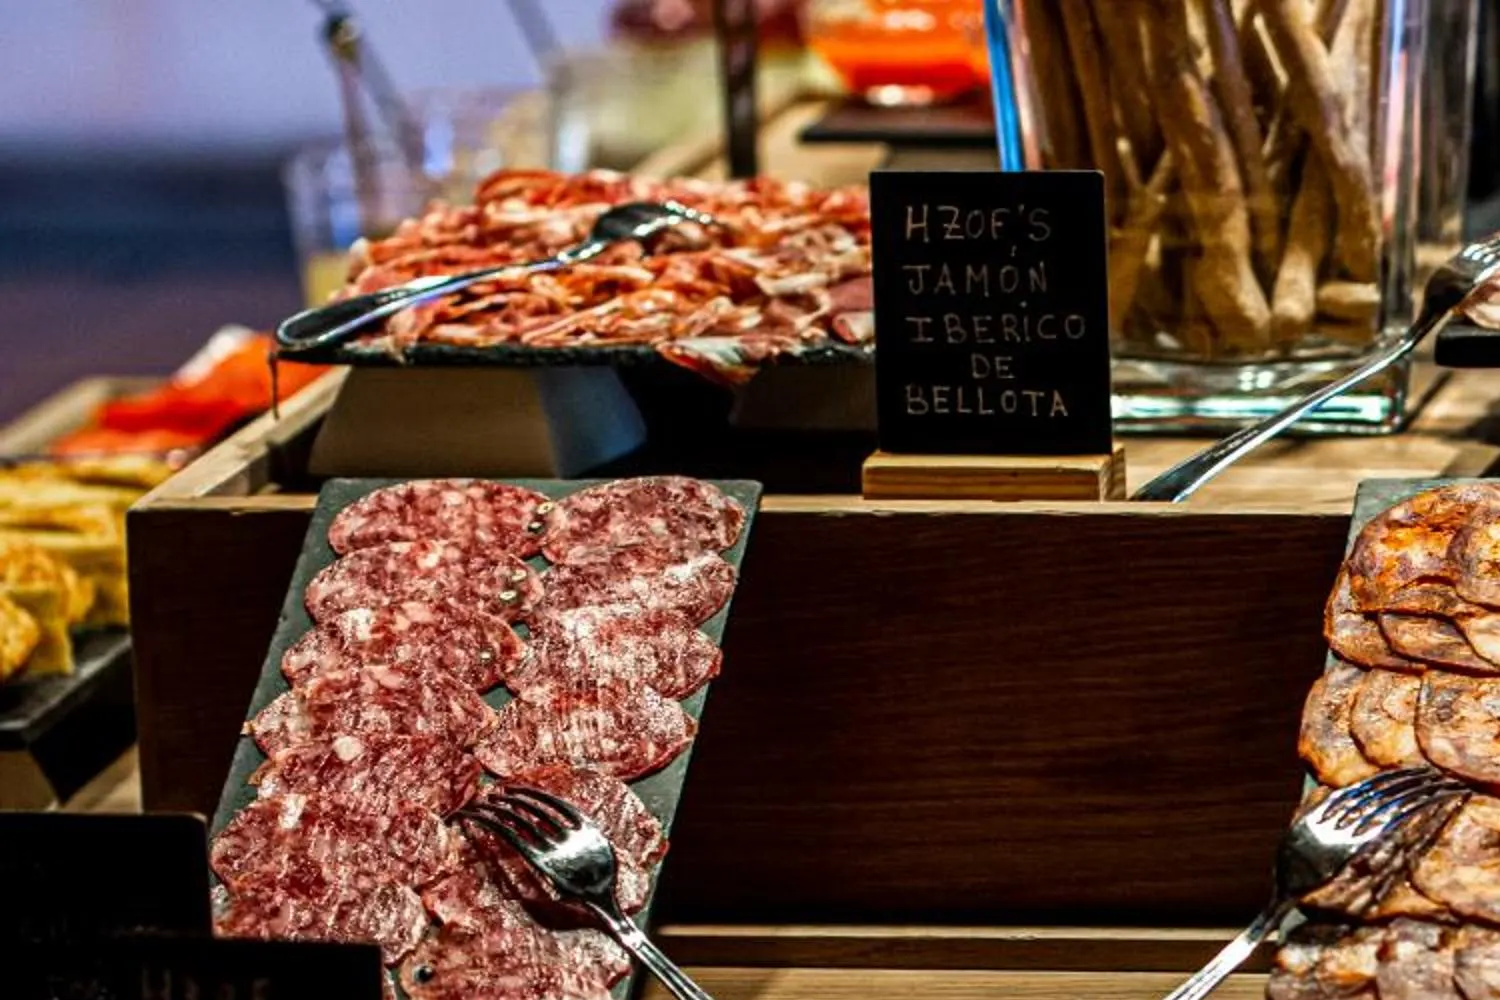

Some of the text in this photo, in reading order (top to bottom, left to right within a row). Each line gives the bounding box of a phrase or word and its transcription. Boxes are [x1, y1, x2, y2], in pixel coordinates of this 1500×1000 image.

[902, 245, 1048, 298] JAMÓN
[970, 352, 1015, 379] DE
[905, 385, 1069, 417] BELLOTA
